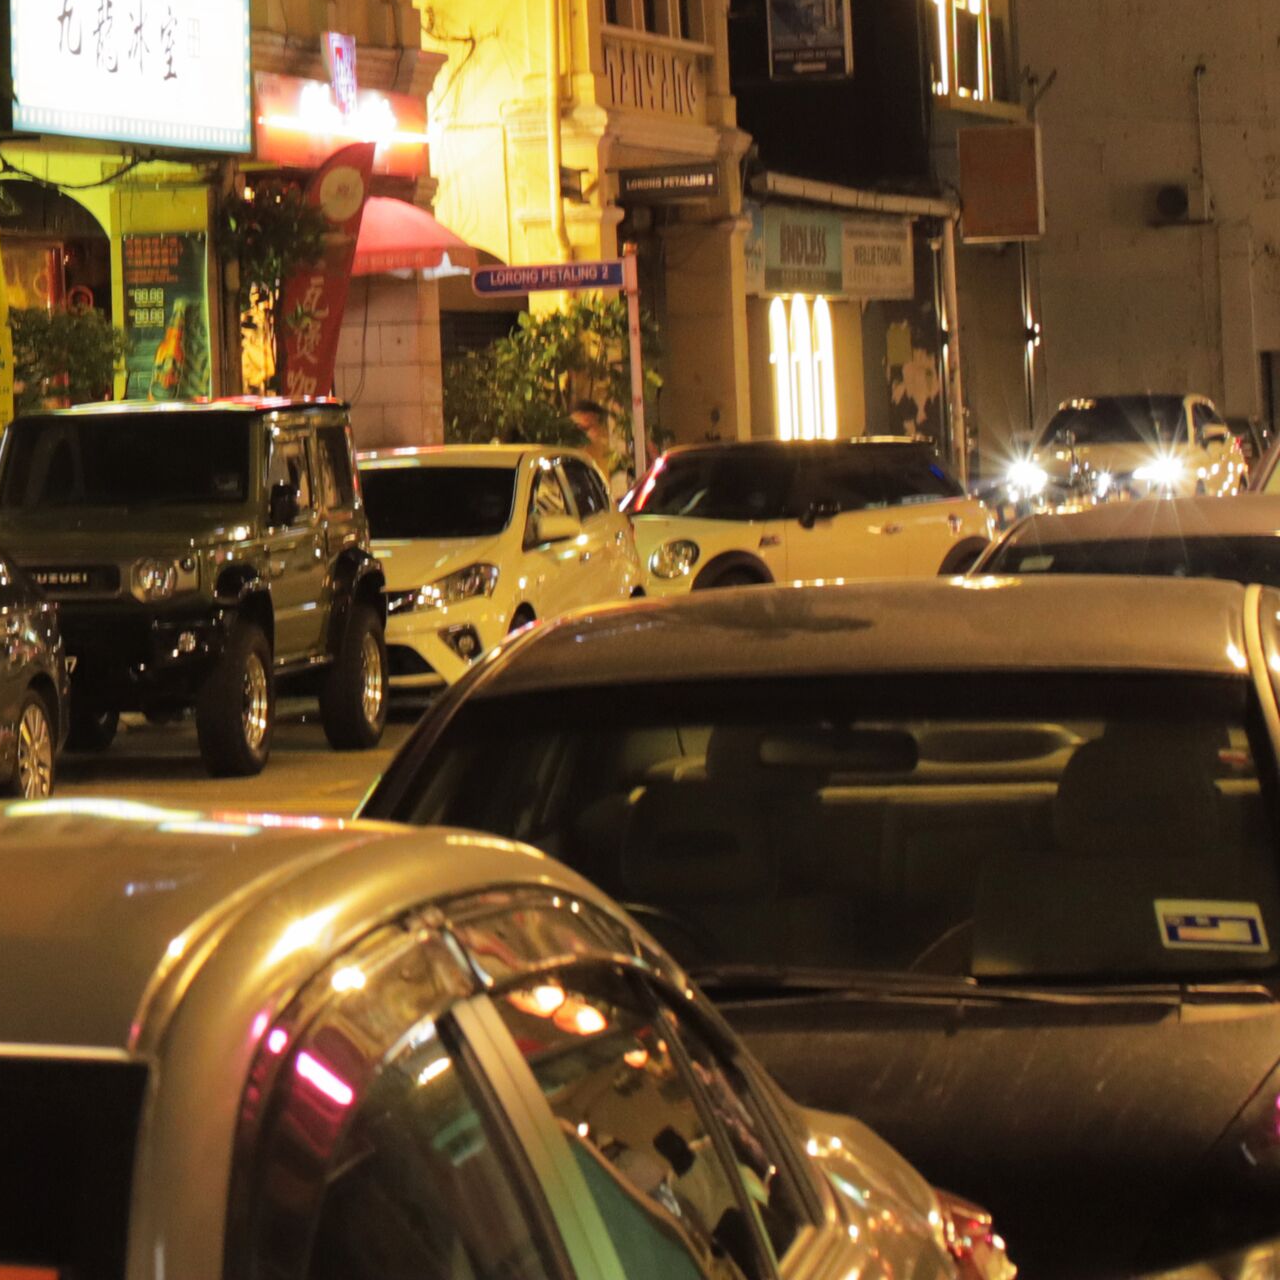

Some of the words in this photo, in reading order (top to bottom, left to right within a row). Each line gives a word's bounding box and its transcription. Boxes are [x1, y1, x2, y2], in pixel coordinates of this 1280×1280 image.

[663, 174, 706, 189] PETALING
[490, 269, 539, 287] LORONG
[542, 266, 598, 283] PETALING
[602, 265, 609, 280] 2
[32, 571, 88, 585] UZUKI
